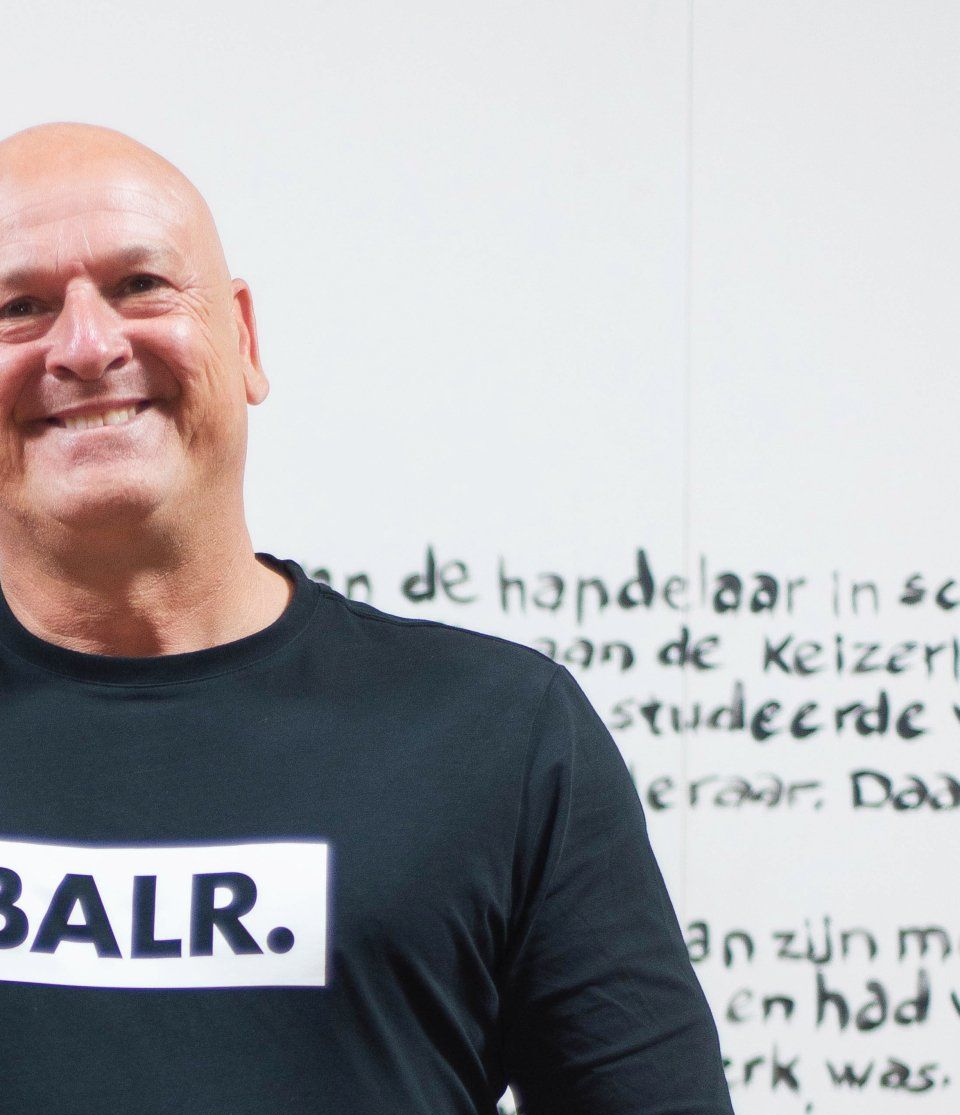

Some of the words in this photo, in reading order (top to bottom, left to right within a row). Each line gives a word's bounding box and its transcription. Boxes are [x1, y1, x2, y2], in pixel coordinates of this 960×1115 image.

[400, 546, 480, 604] de
[499, 548, 805, 623] handelaar
[834, 570, 877, 611] in
[656, 625, 720, 672] de
[613, 681, 927, 743] studeerde
[772, 915, 878, 961] zijn
[725, 990, 796, 1024] en
[816, 968, 931, 1027] had
[826, 1057, 950, 1094] was.
